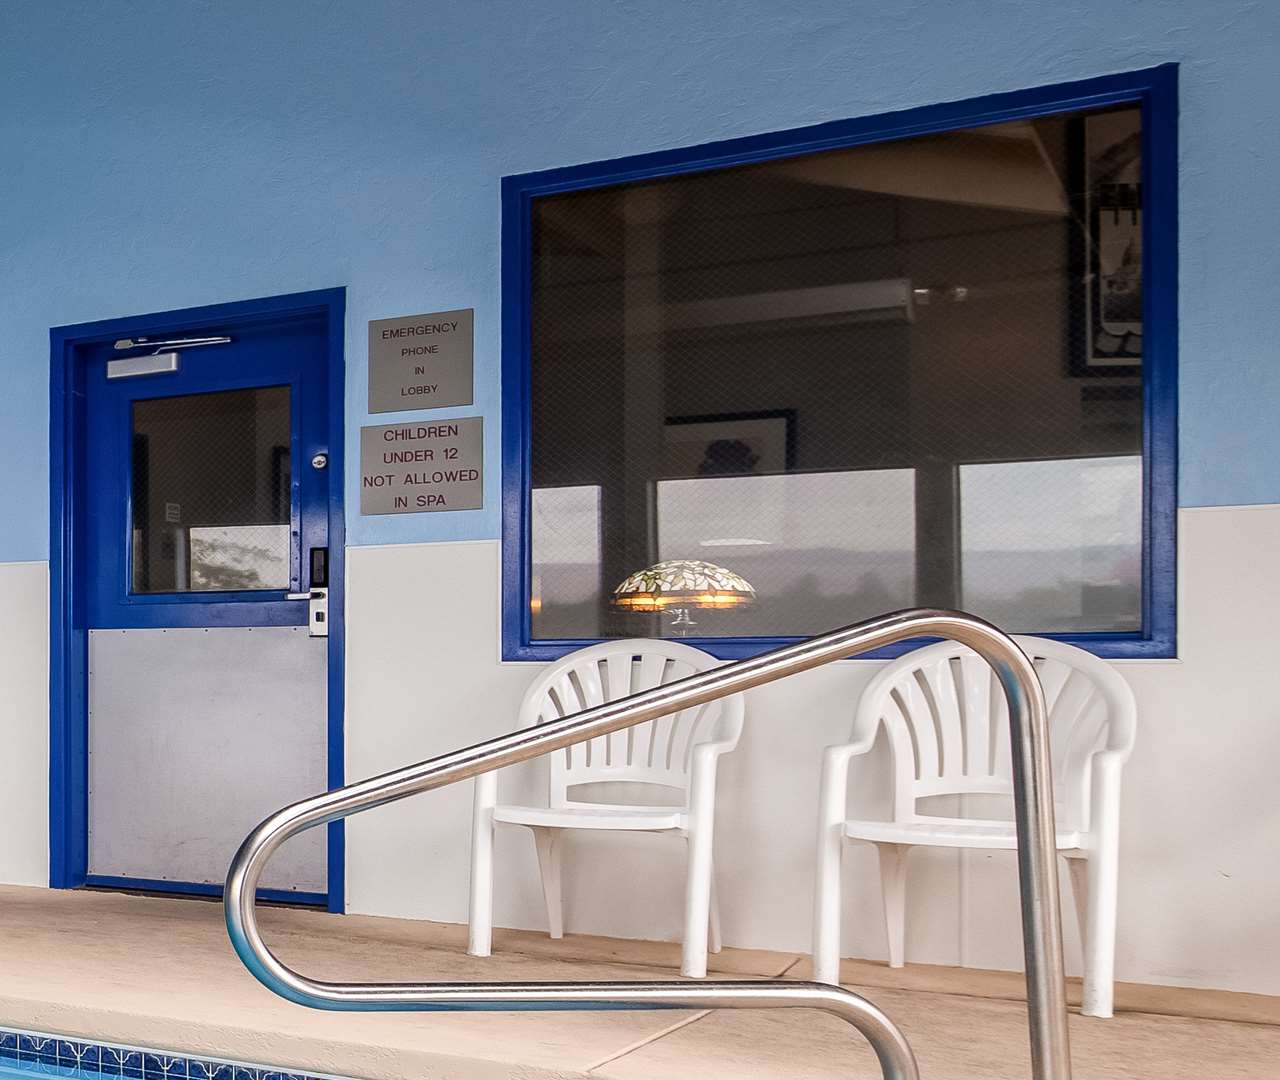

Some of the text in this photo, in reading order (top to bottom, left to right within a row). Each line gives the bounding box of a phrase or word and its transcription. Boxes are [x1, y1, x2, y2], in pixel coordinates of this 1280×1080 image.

[382, 321, 458, 340] EMERGENCY
[401, 344, 439, 357] PHONE
[414, 366, 425, 375] IN
[400, 384, 439, 396] LOBBY
[383, 425, 458, 442] CHILDREN
[383, 447, 458, 464] UNDER 12
[363, 469, 479, 488] NOT ALLOWED
[394, 494, 447, 508] IN SPA
